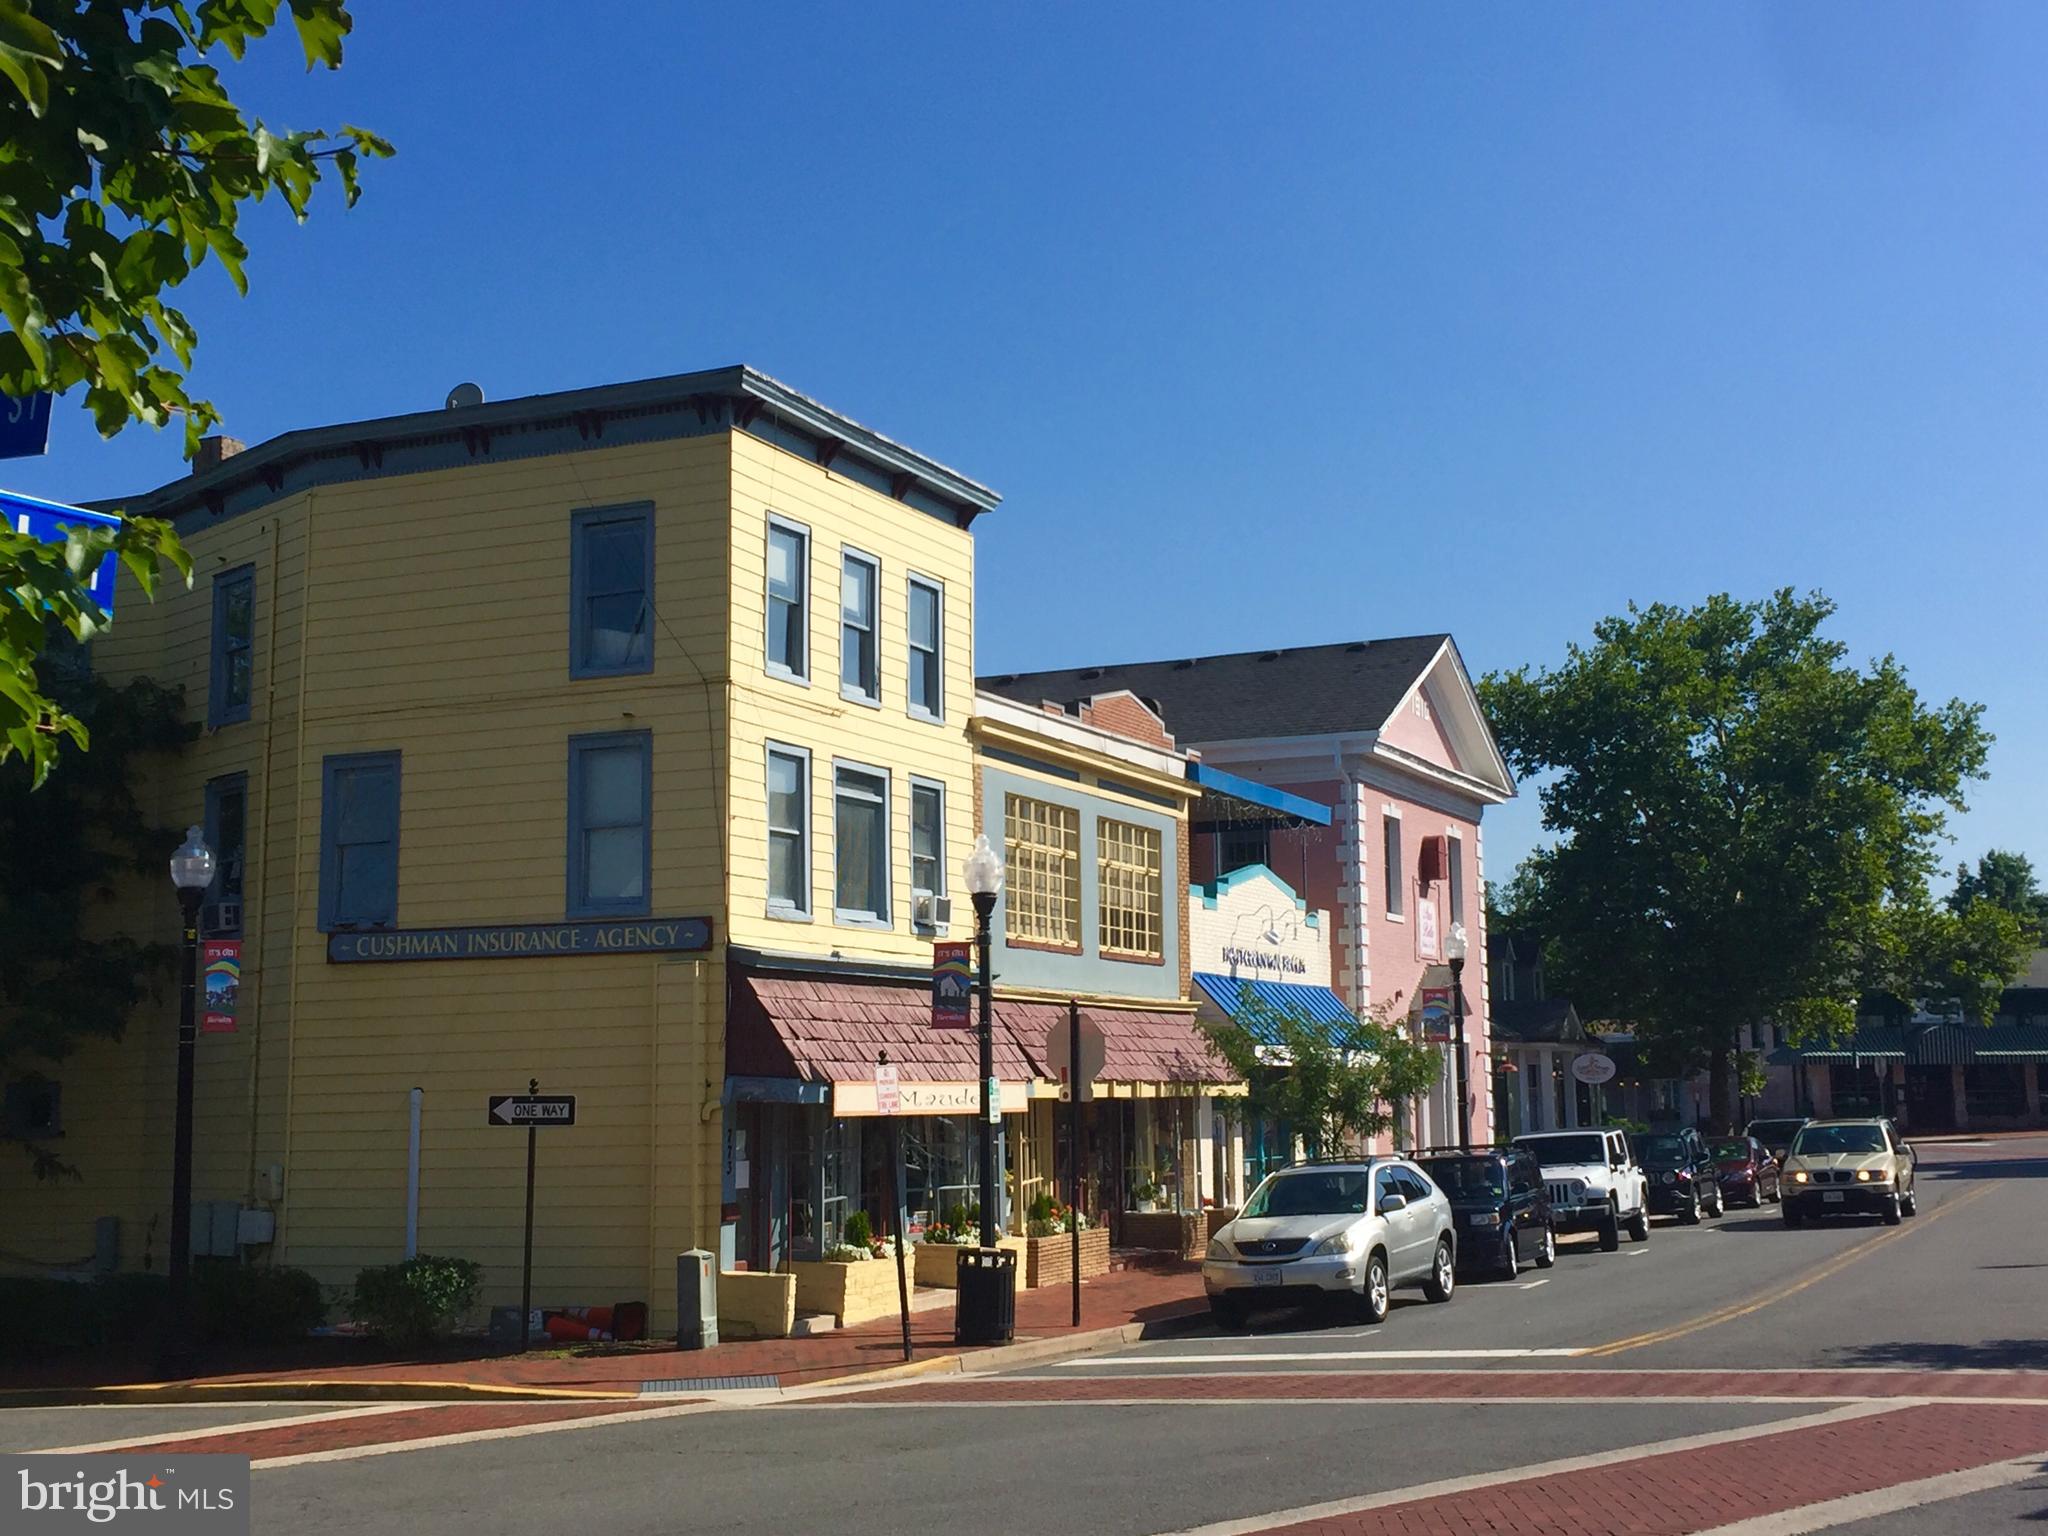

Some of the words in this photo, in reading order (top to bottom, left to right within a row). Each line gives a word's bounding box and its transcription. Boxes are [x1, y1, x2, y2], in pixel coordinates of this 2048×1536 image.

[356, 934, 458, 956] CUSHMAN
[467, 929, 580, 953] INSURANCE
[594, 925, 679, 947] AGENCY
[514, 1104, 538, 1117] ONE
[542, 1104, 566, 1117] WAY
